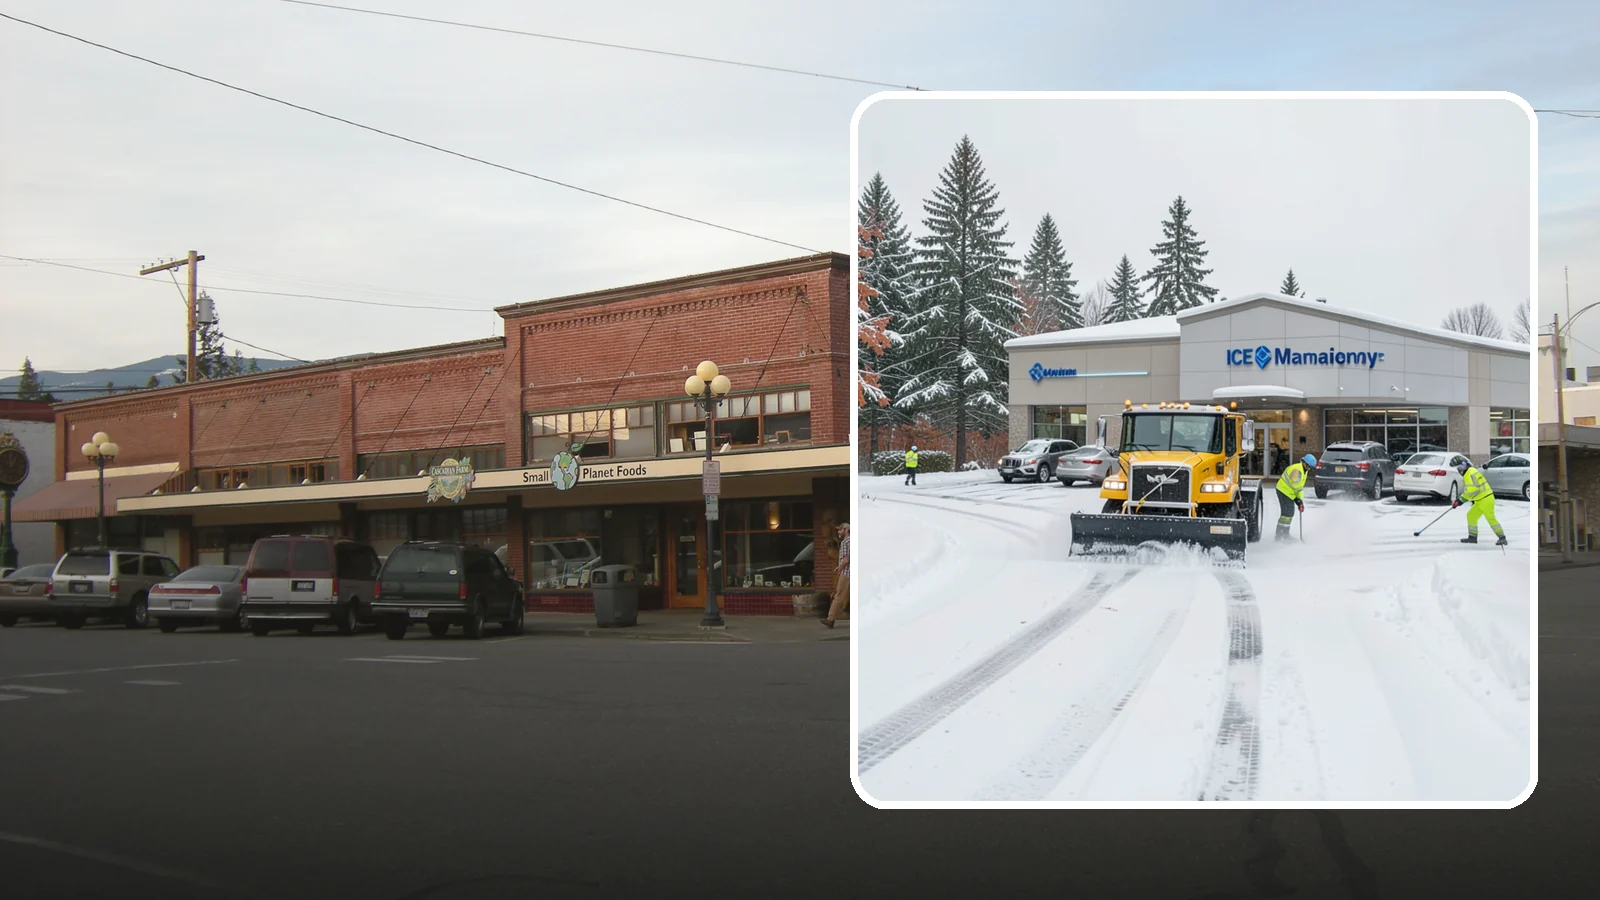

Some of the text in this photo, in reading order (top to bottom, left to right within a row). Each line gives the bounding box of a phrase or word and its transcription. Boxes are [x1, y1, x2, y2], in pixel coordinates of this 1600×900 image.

[1226, 349, 1253, 365] ICE
[523, 464, 647, 482] Small Planet Foods
